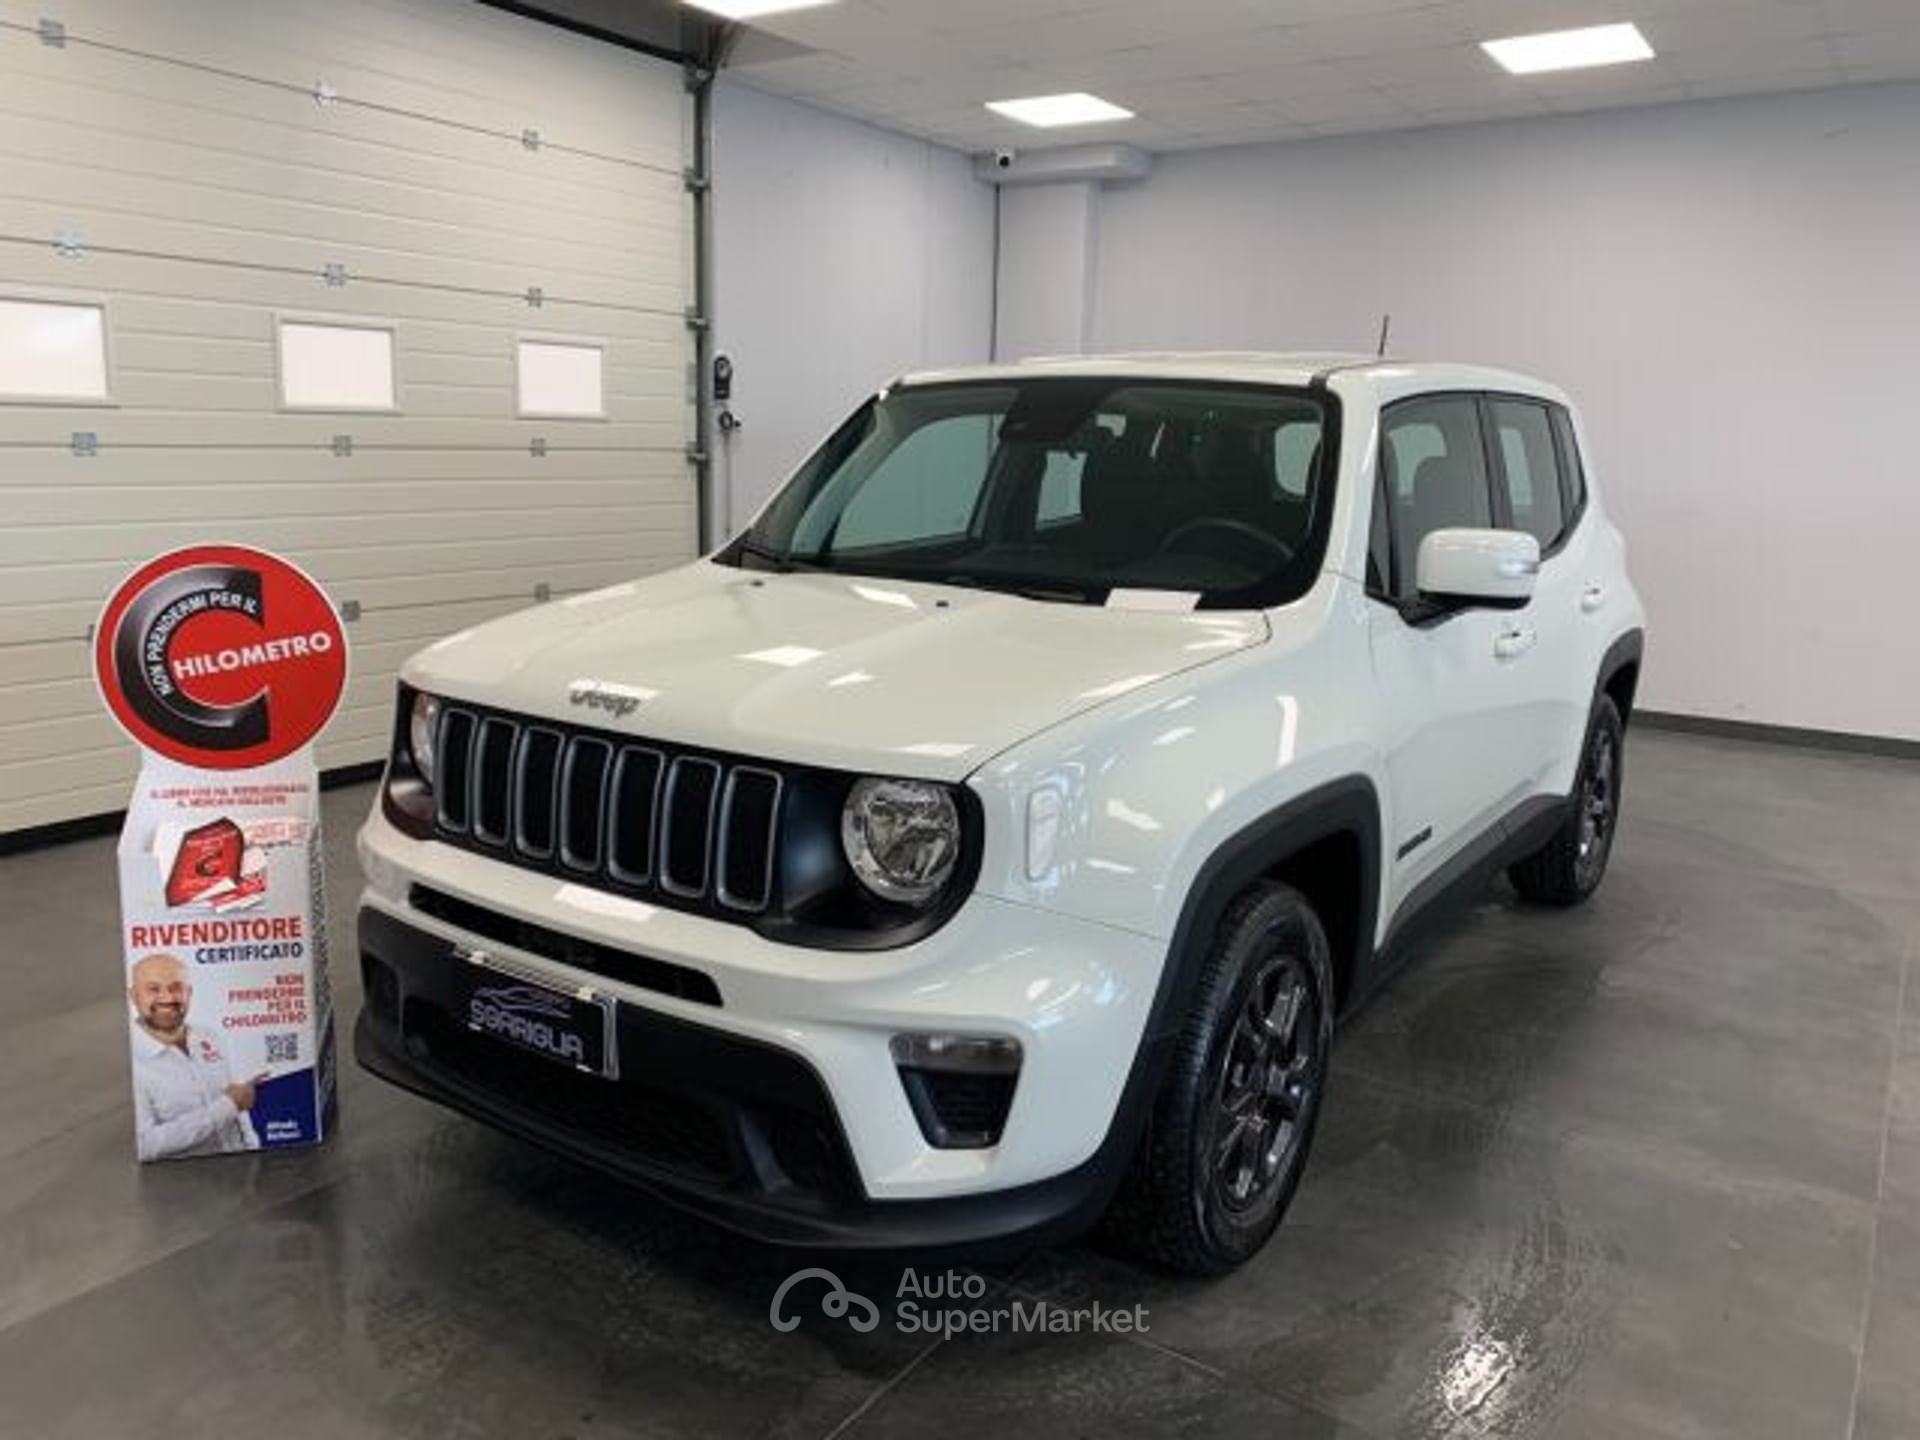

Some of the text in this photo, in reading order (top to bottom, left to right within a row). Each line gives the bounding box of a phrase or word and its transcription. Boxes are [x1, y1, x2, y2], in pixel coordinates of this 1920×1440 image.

[210, 591, 242, 608] PER
[173, 631, 332, 680] HILOMETRO
[131, 917, 302, 948] RIVENDITORE
[195, 943, 303, 964] CERTIFICATO
